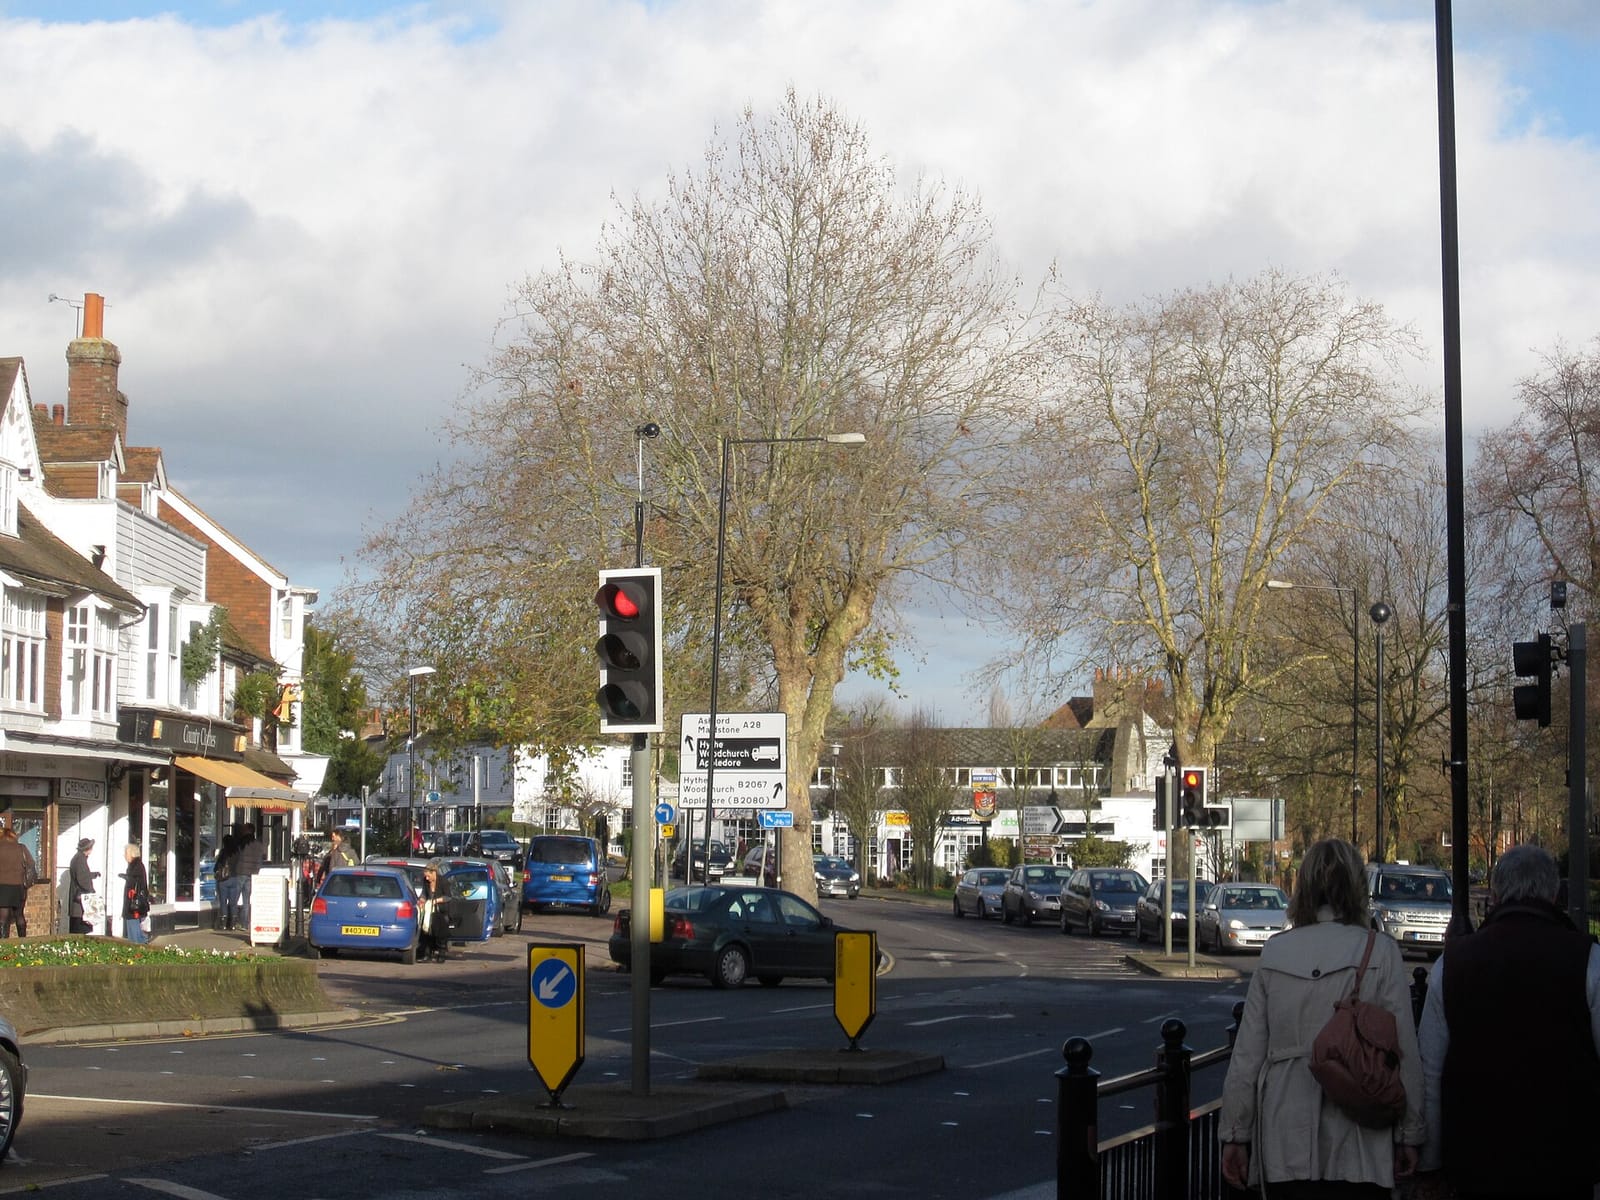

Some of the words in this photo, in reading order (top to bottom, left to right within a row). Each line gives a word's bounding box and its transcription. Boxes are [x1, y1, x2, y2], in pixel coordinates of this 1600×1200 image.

[743, 721, 761, 729] A28
[183, 724, 200, 751] County
[699, 740, 724, 750] Hyhe
[698, 758, 742, 768] Apledore
[65, 780, 100, 799] GREYHOUND
[738, 781, 768, 789] B2067
[682, 796, 725, 805] Appleore
